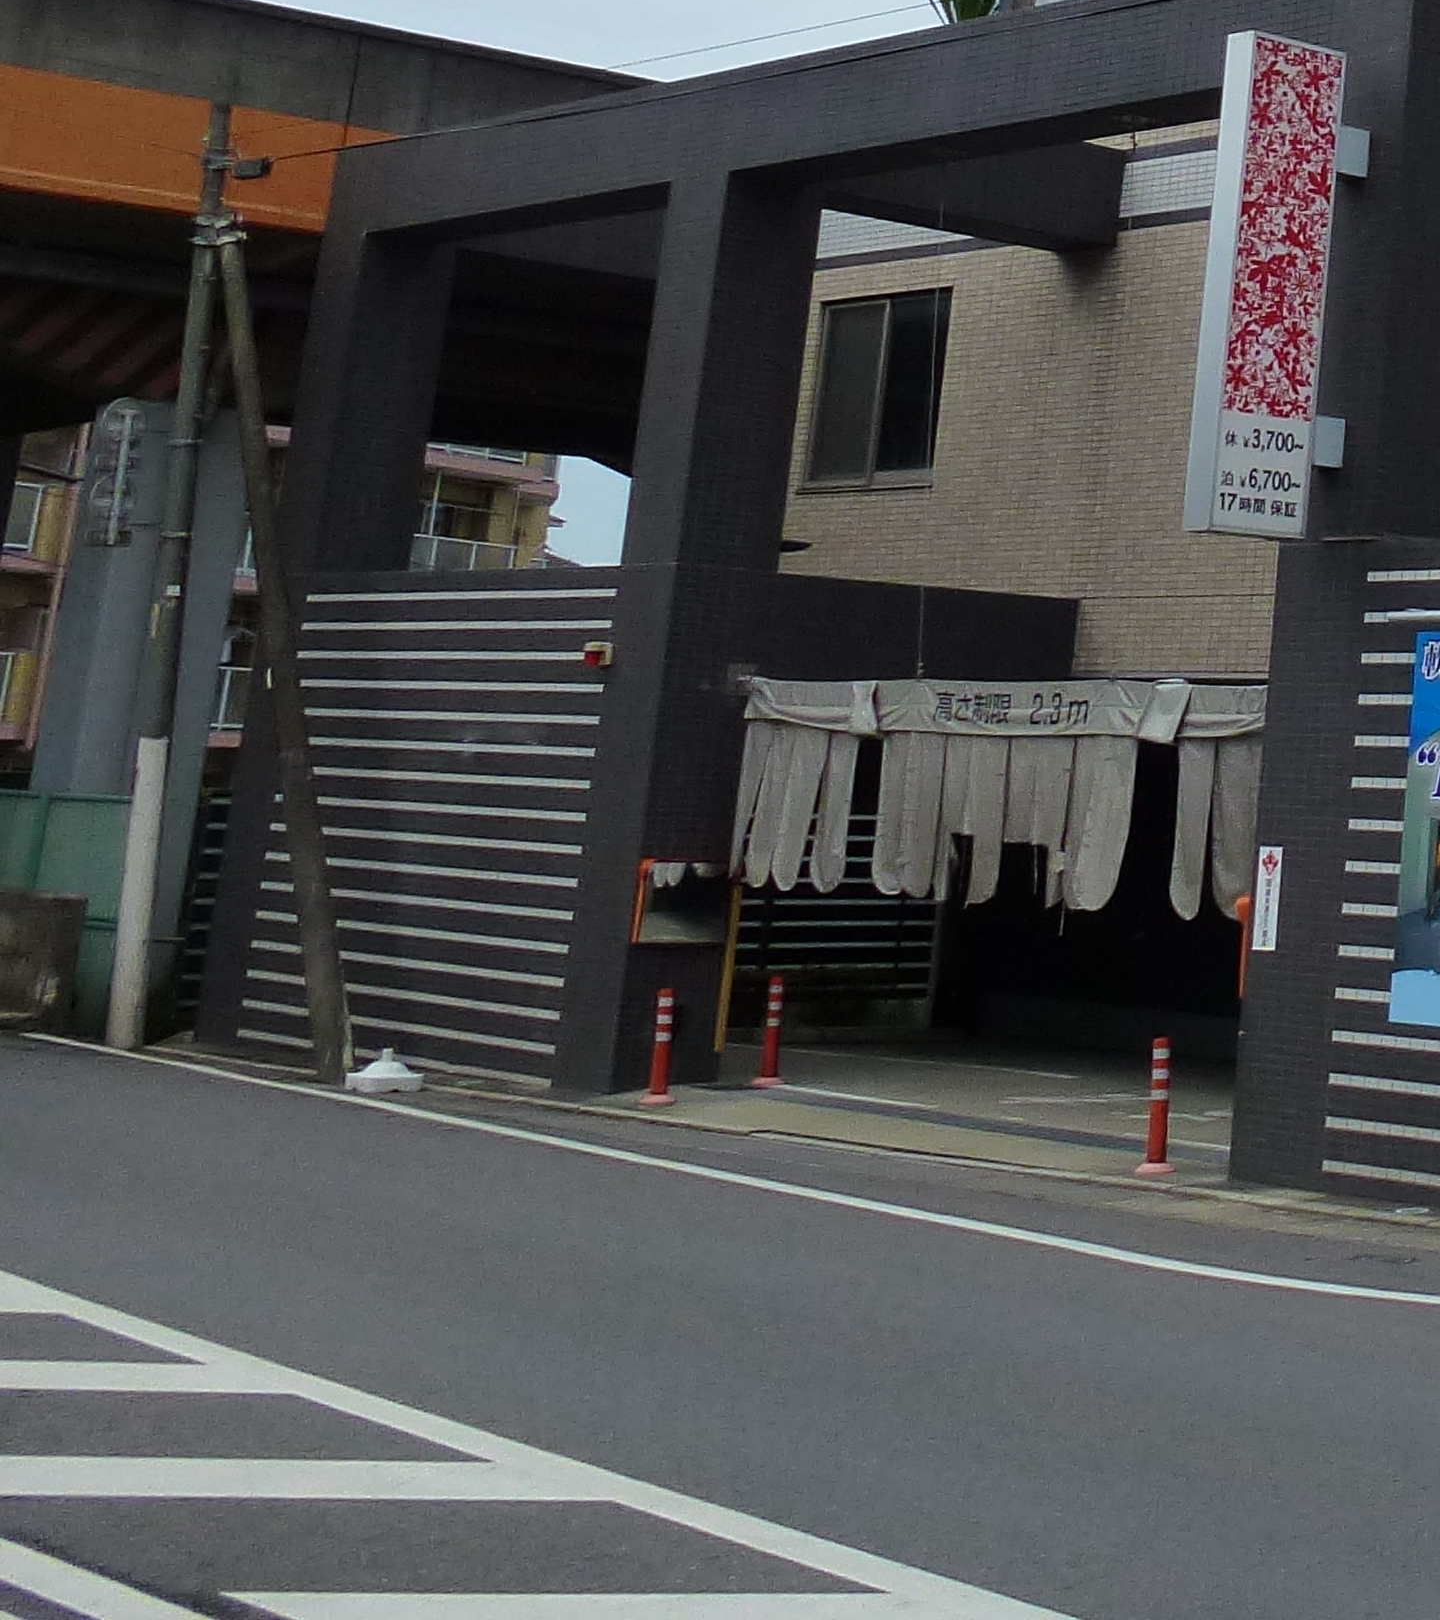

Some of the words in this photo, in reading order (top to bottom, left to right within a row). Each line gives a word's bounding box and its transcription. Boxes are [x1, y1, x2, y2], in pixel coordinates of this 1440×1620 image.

[1225, 429, 1238, 447] 休
[1220, 470, 1234, 486] 泊
[934, 692, 1011, 724] 高さ制限
